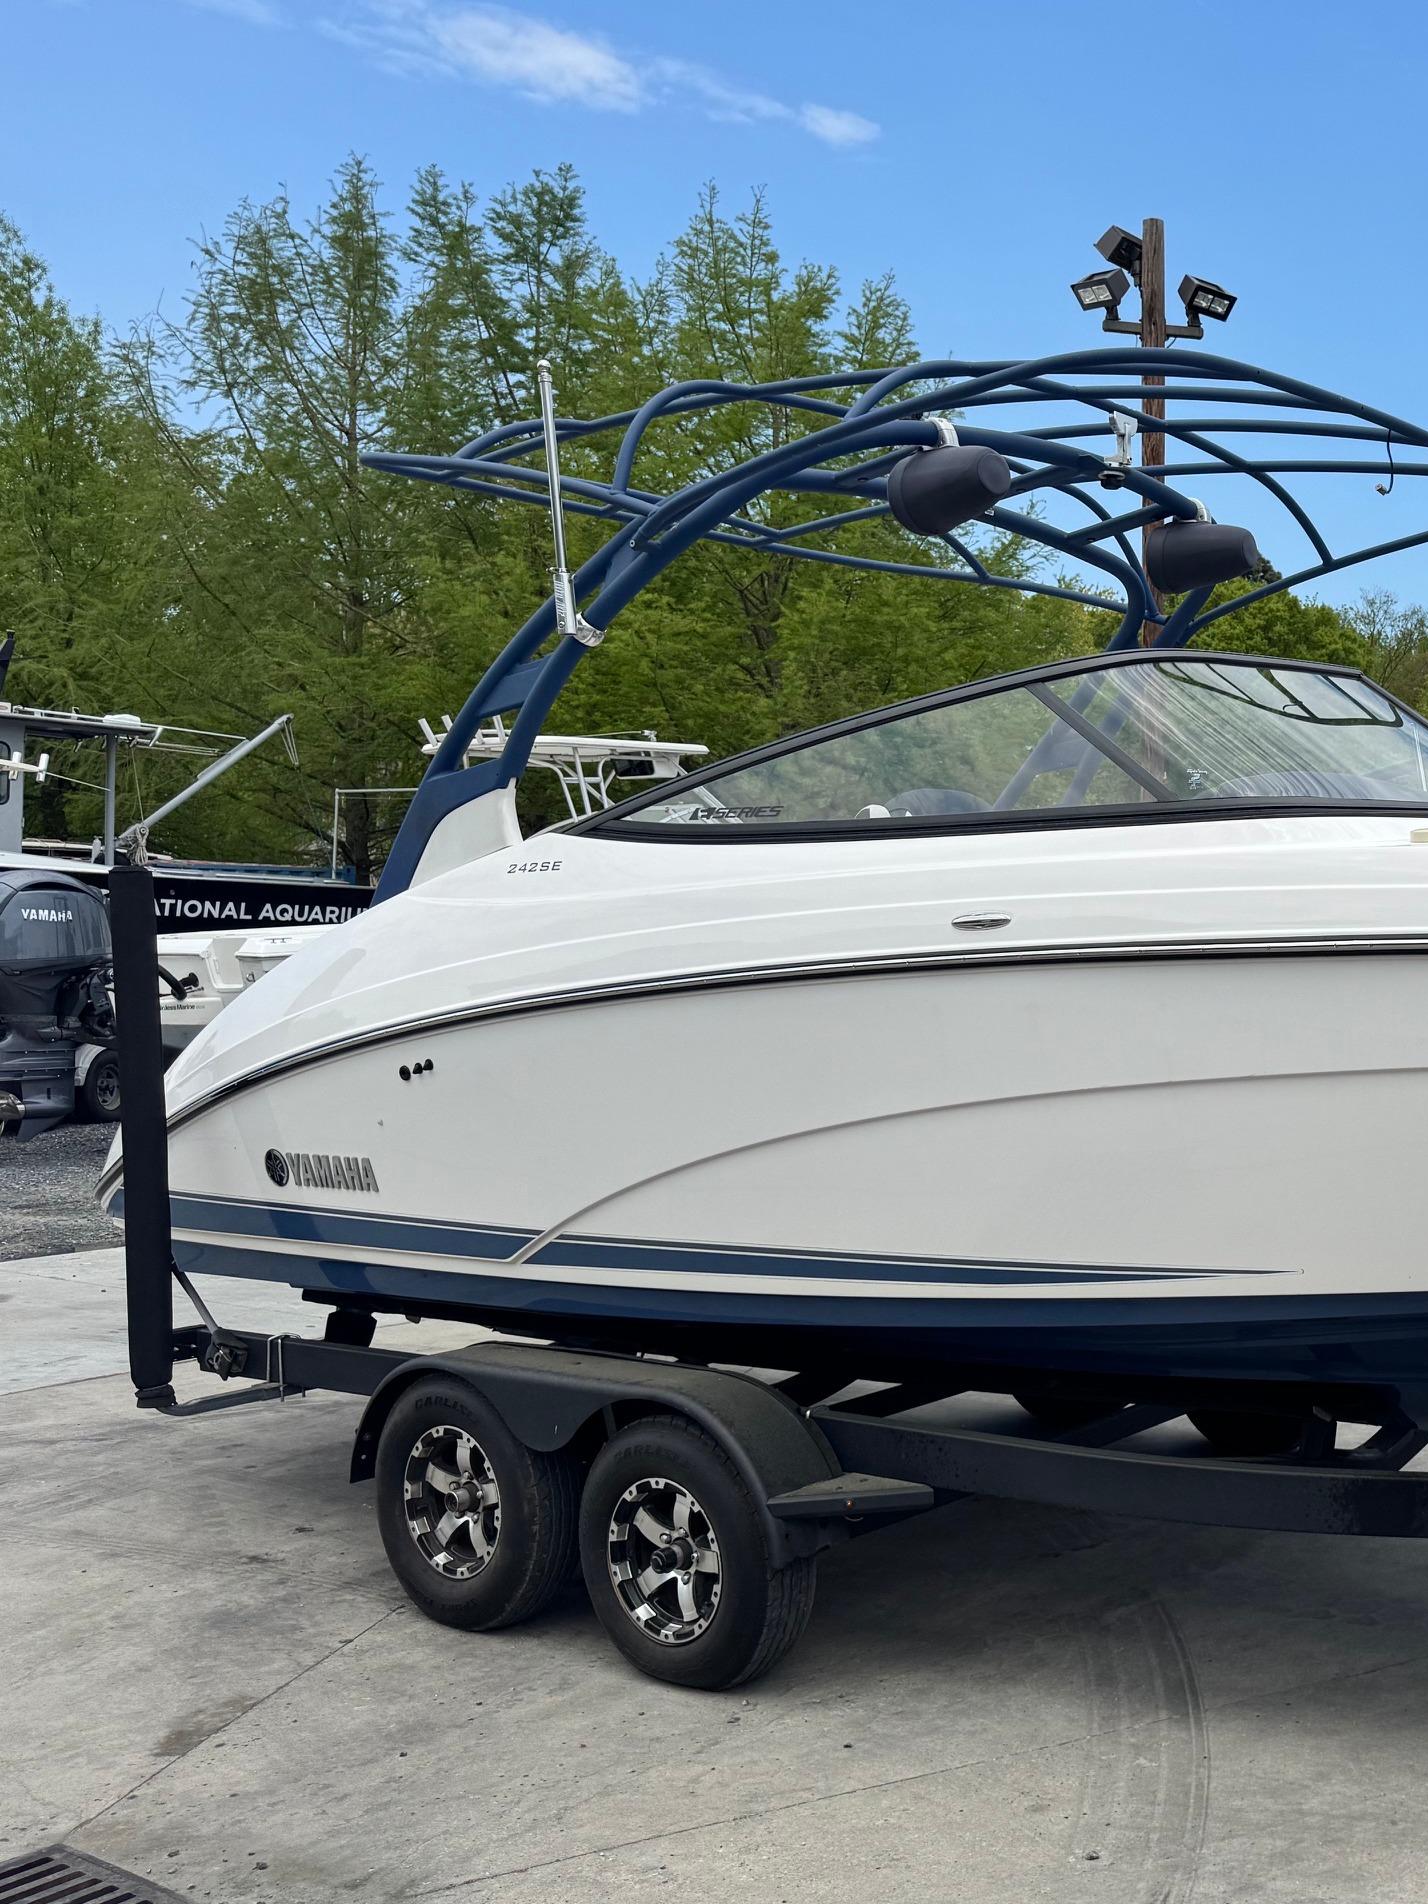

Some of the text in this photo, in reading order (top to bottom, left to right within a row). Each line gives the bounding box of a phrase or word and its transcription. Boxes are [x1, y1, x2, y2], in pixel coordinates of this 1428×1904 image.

[507, 860, 563, 874] 242SE
[21, 908, 73, 922] YAMAHA
[153, 898, 370, 923] TIONAL AQUARI
[285, 1152, 380, 1193] YAMAHA
